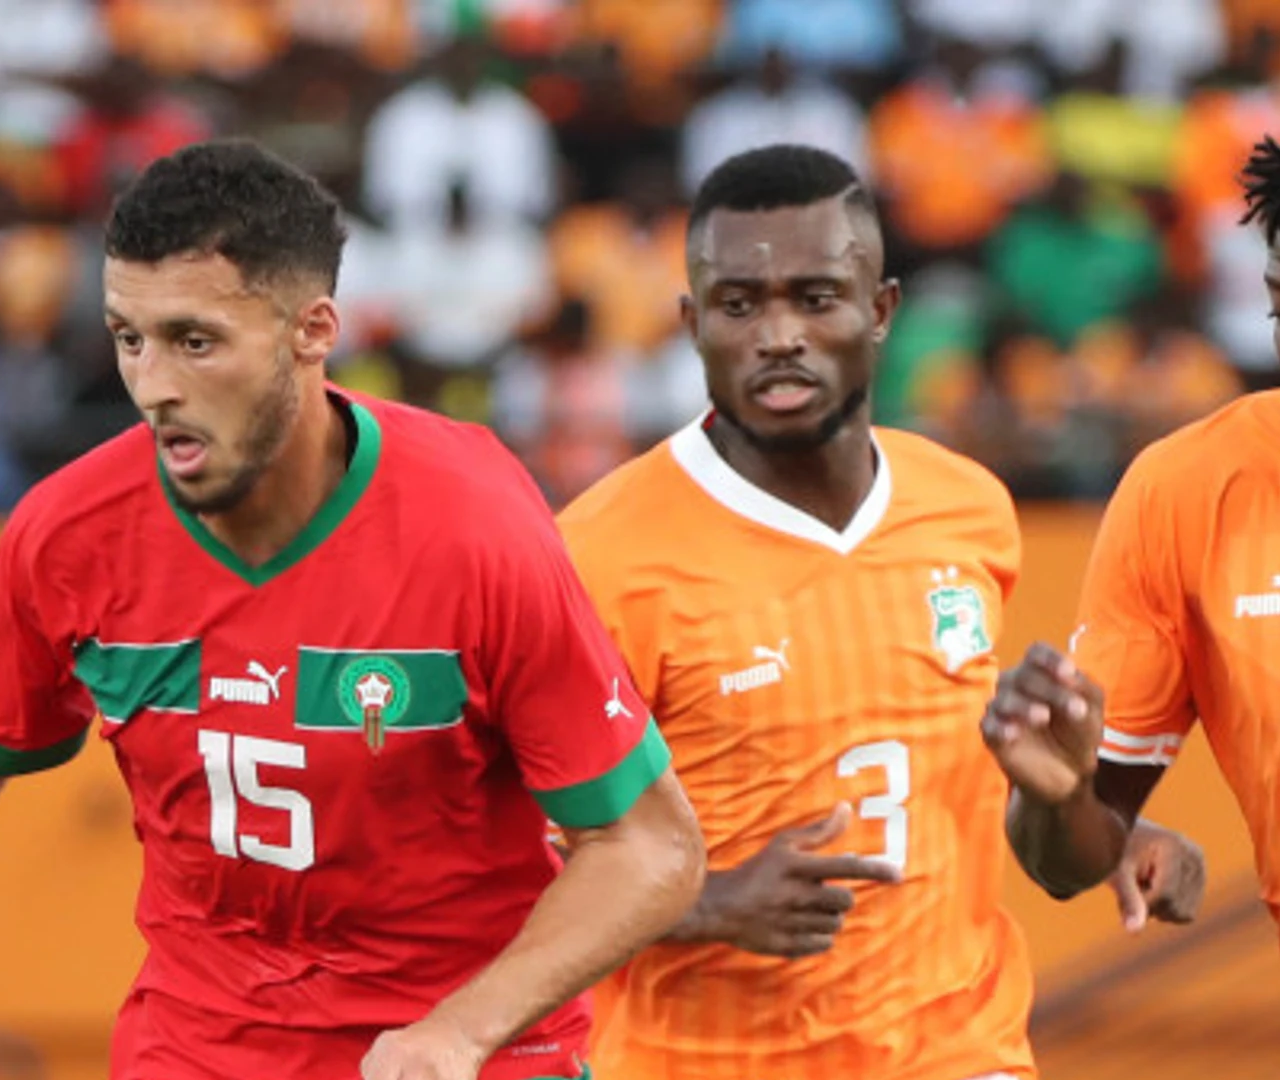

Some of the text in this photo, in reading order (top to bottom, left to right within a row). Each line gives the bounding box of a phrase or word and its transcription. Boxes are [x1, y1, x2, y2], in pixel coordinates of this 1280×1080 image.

[209, 677, 269, 705] PUMA
[720, 662, 779, 695] PUMA
[198, 729, 315, 872] 15
[837, 740, 909, 876] 3
